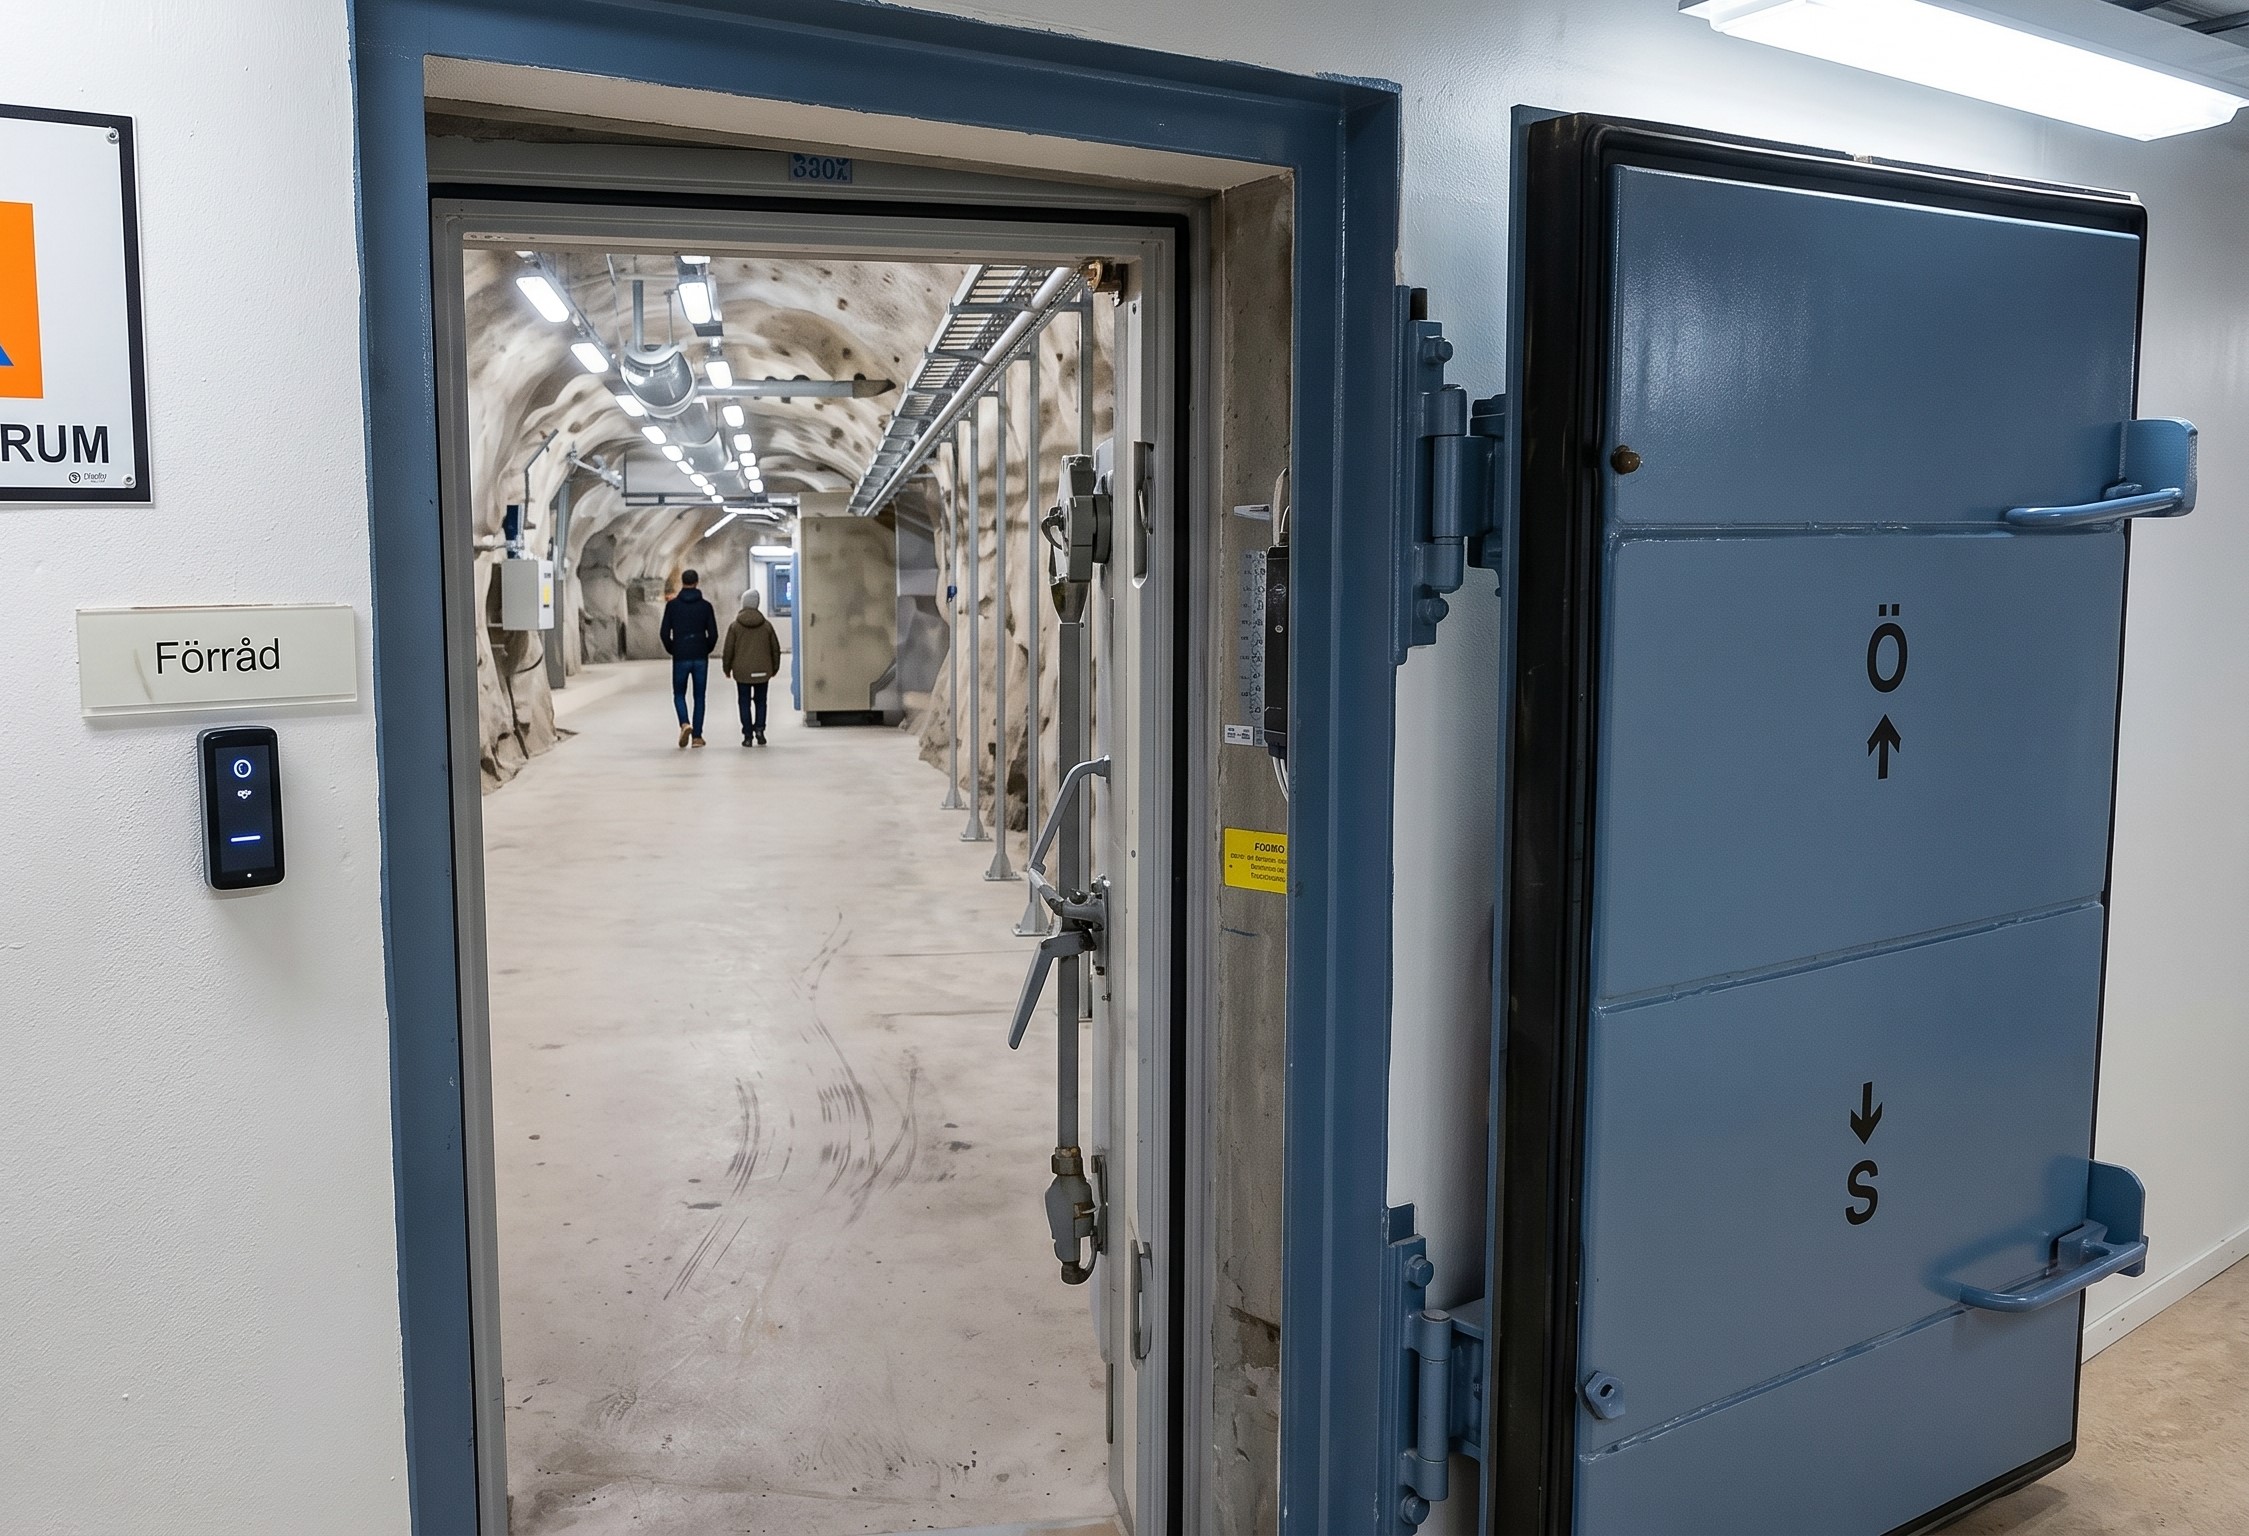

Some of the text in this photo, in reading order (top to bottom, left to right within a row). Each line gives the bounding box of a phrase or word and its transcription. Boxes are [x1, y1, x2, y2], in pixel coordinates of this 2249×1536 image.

[0, 424, 109, 463] RUM
[156, 638, 280, 674] Förråd
[1867, 604, 1908, 693] Ö
[1845, 1160, 1878, 1226] S
